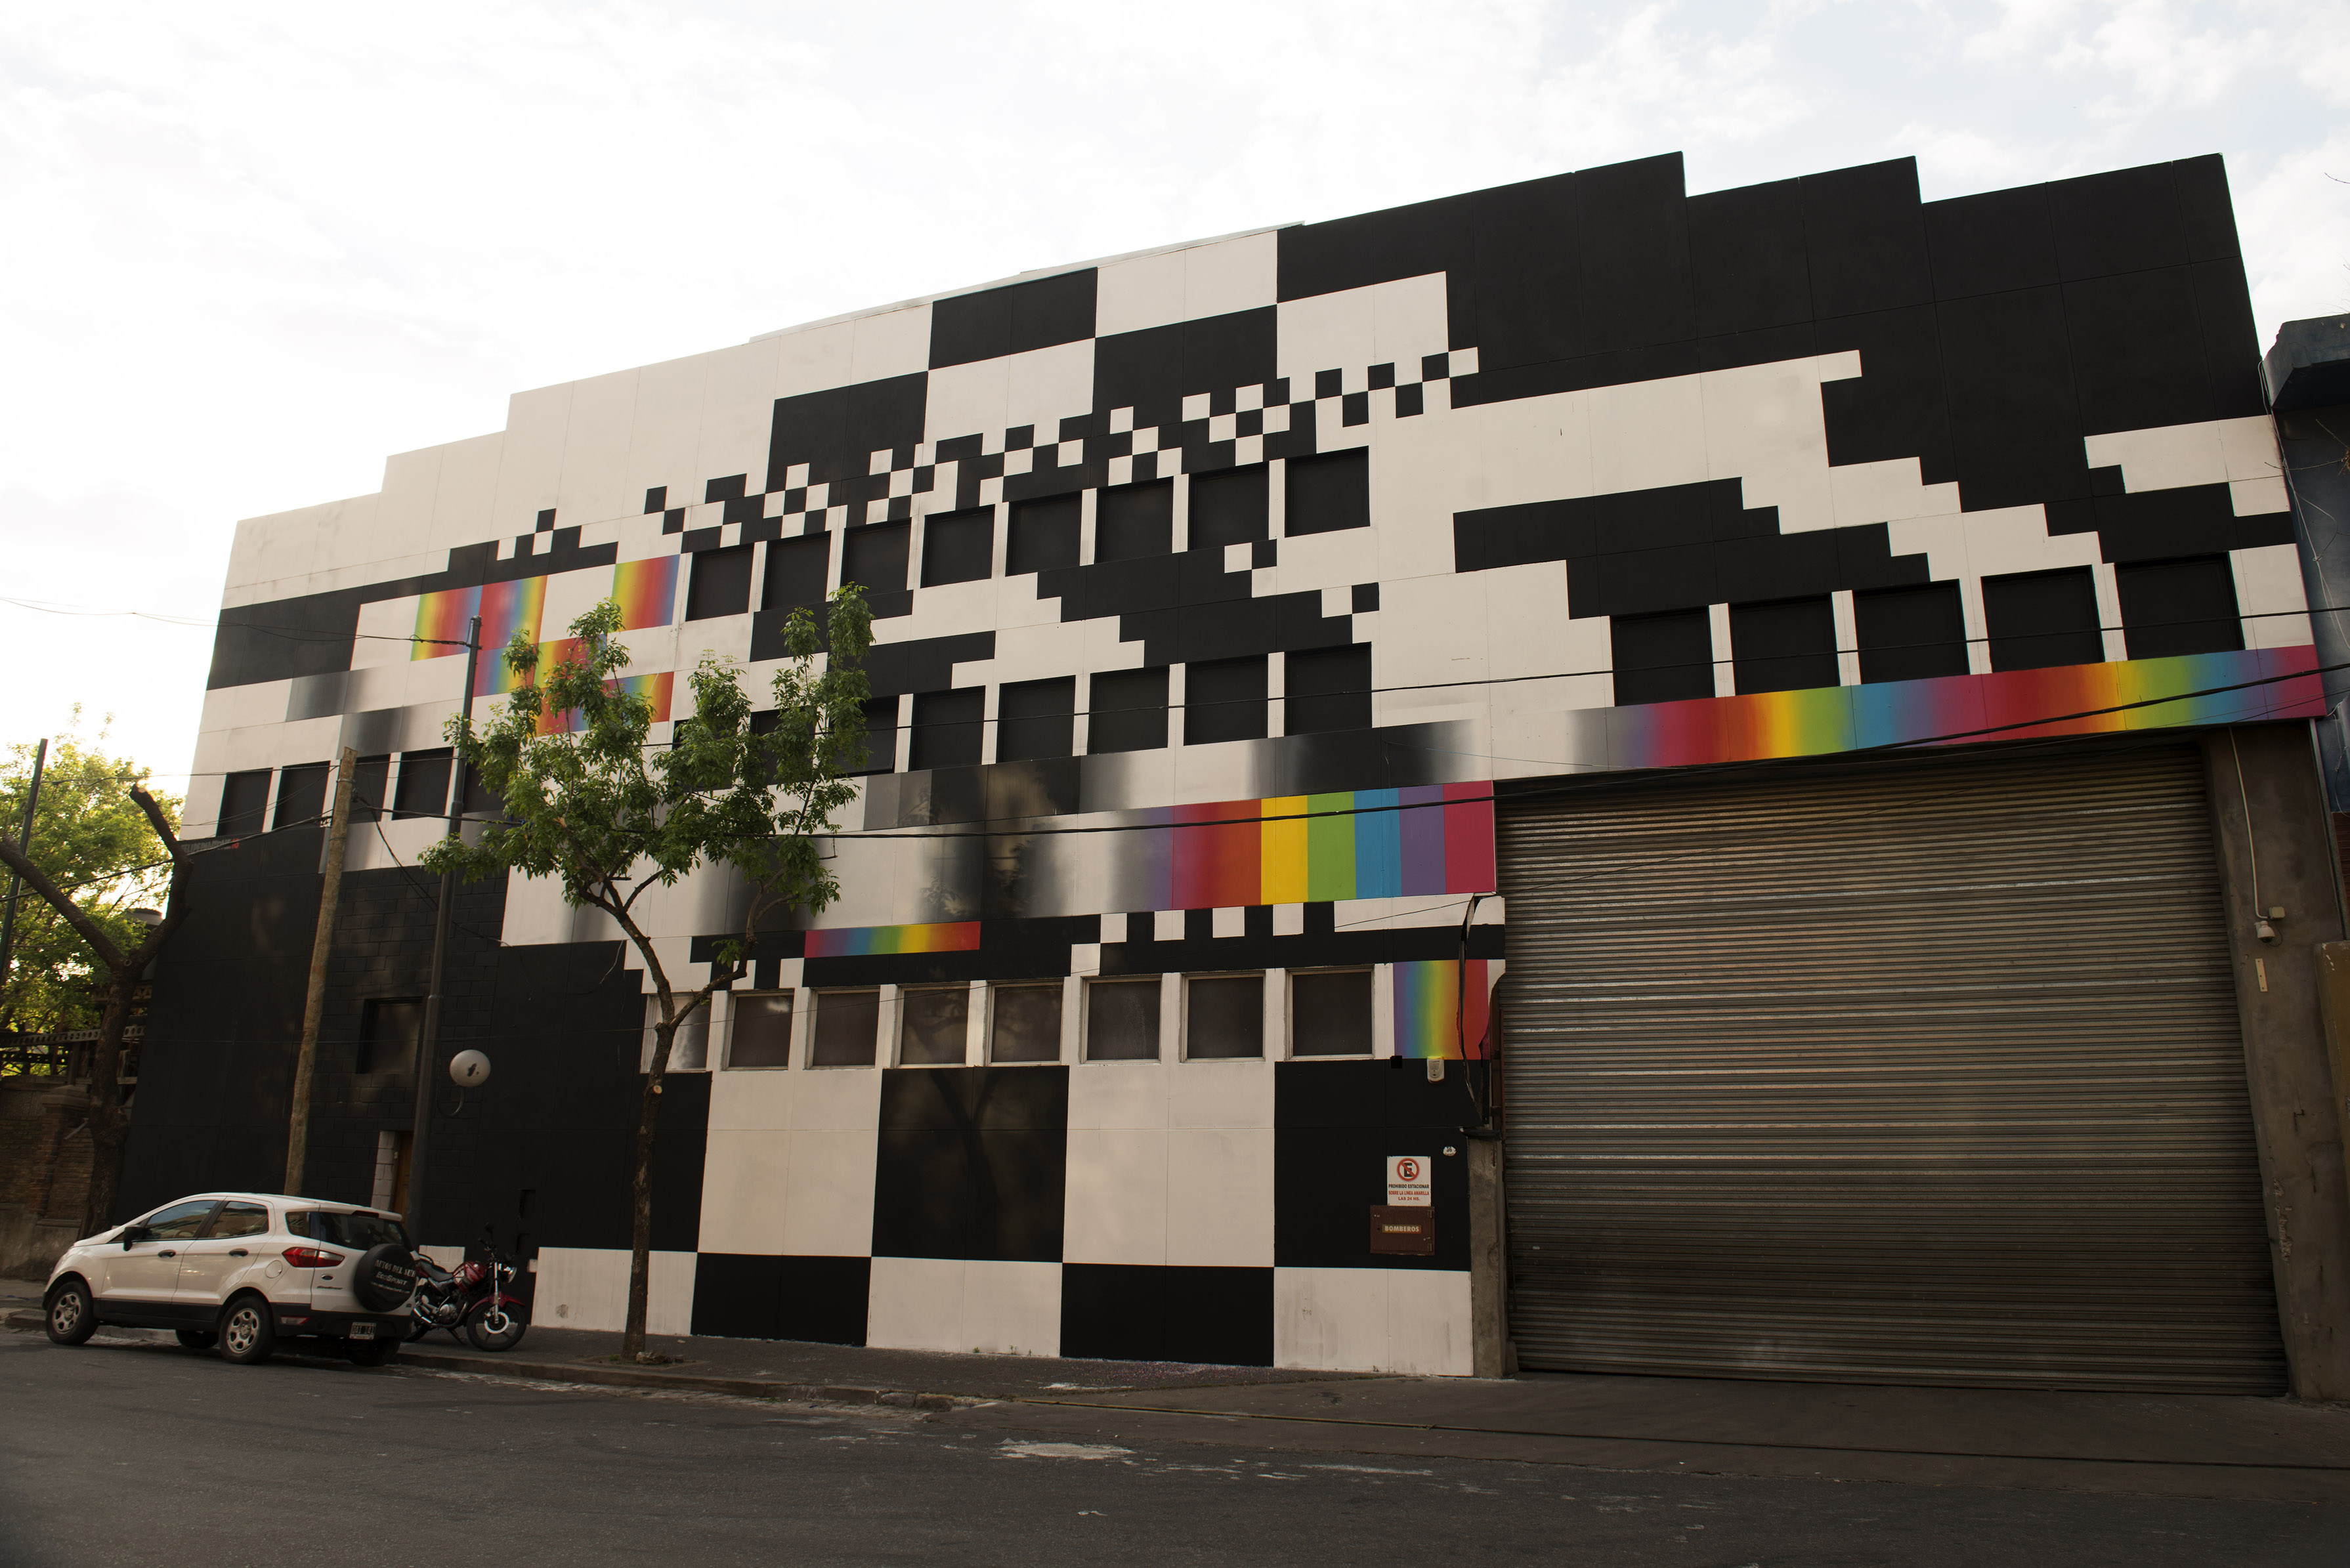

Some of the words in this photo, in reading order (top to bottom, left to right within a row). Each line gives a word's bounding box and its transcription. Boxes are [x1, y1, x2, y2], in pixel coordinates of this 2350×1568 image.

[375, 1260, 393, 1271] AUTOS
[392, 1265, 403, 1275] DEL
[403, 1269, 416, 1278] SUR
